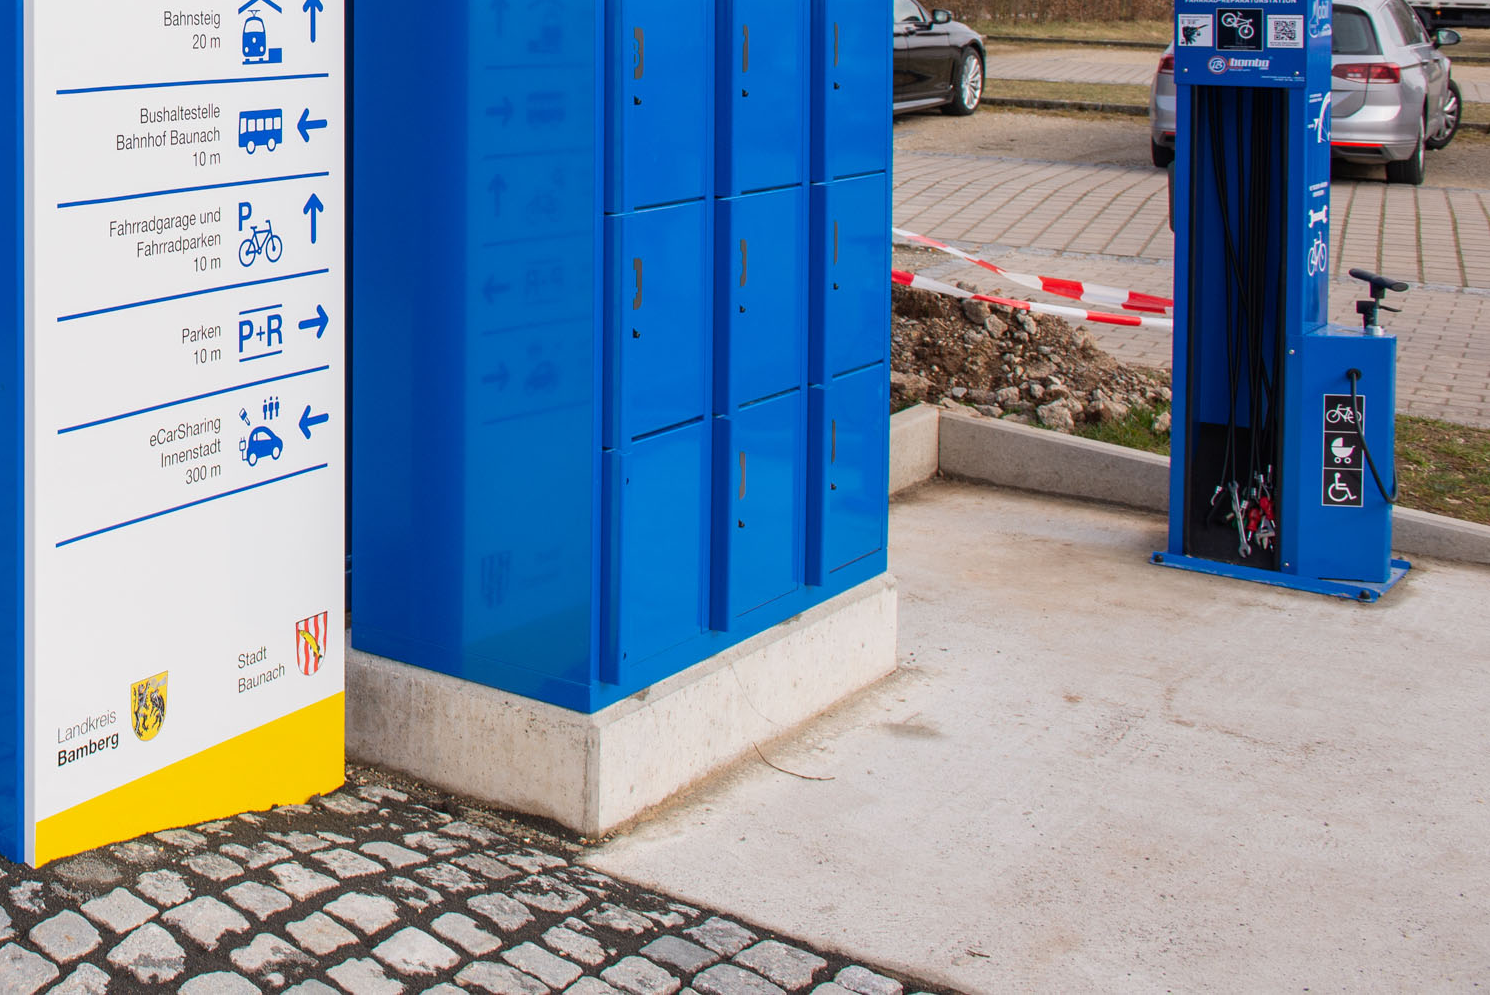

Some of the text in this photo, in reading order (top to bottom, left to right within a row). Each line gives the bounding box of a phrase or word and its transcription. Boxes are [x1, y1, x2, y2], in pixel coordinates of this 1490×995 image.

[163, 11, 221, 28] Bahnsteig
[192, 34, 221, 49] 20 m
[140, 104, 220, 124] Bushaltestelle
[116, 128, 220, 151] Bahnhof Baunach
[193, 152, 221, 166] 10 m
[109, 207, 221, 237] Fahrradgarage und
[238, 201, 252, 231] P
[137, 233, 221, 257] Fahrradparken
[193, 257, 221, 272] 10 m
[182, 324, 221, 344] Parken
[239, 314, 283, 353] P+R
[193, 348, 221, 365] 10 m
[149, 417, 221, 447] eCarSharing
[161, 439, 221, 468] Innenstadt
[185, 464, 221, 485] 300 m
[238, 646, 267, 669] Stadt
[238, 663, 285, 693] Baunach
[57, 709, 117, 744] Landkreis
[57, 732, 119, 767] Bamberg
